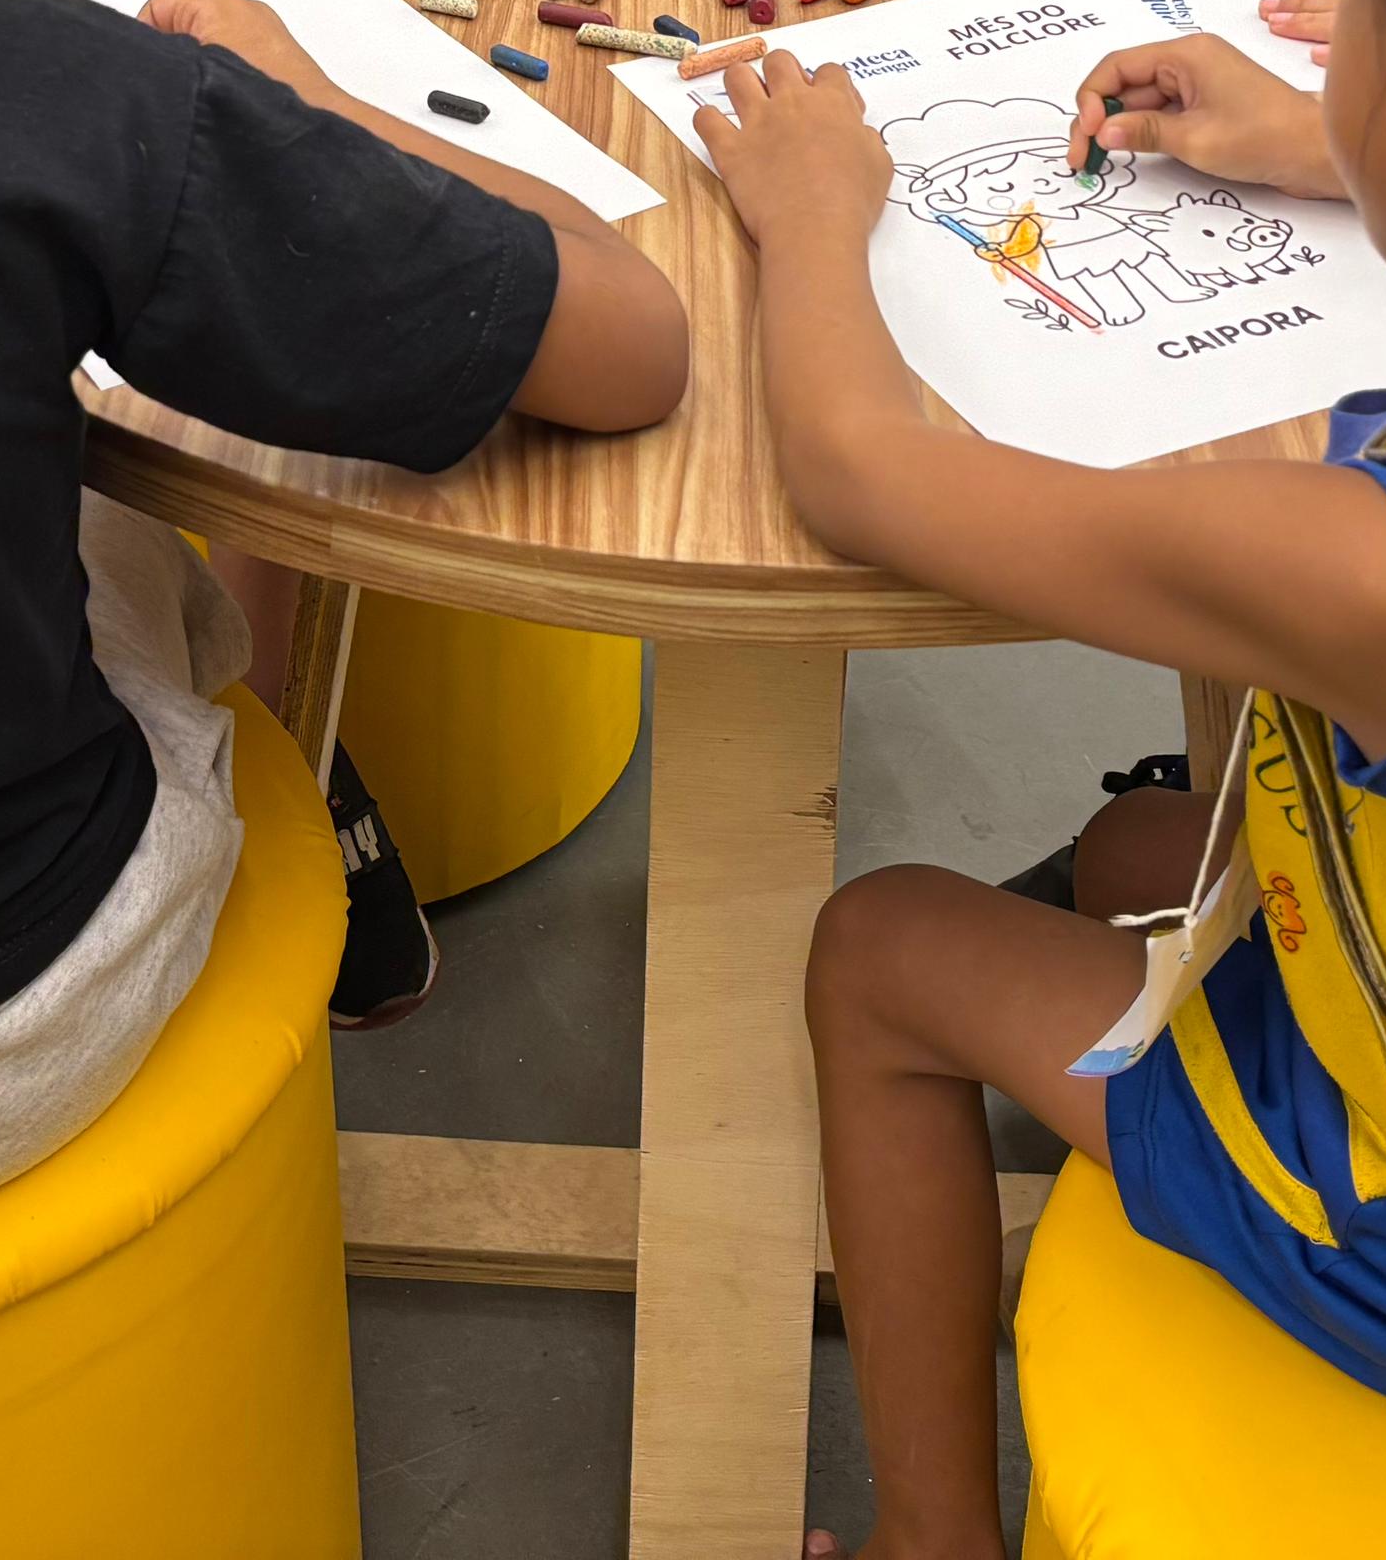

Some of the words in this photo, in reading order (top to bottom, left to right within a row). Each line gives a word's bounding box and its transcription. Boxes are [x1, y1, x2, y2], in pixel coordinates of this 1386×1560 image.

[947, 13, 1106, 60] FOLCLORE
[948, 16, 1015, 41] MÊS
[1017, 4, 1066, 24] DO
[1157, 306, 1325, 359] CAIPORA
